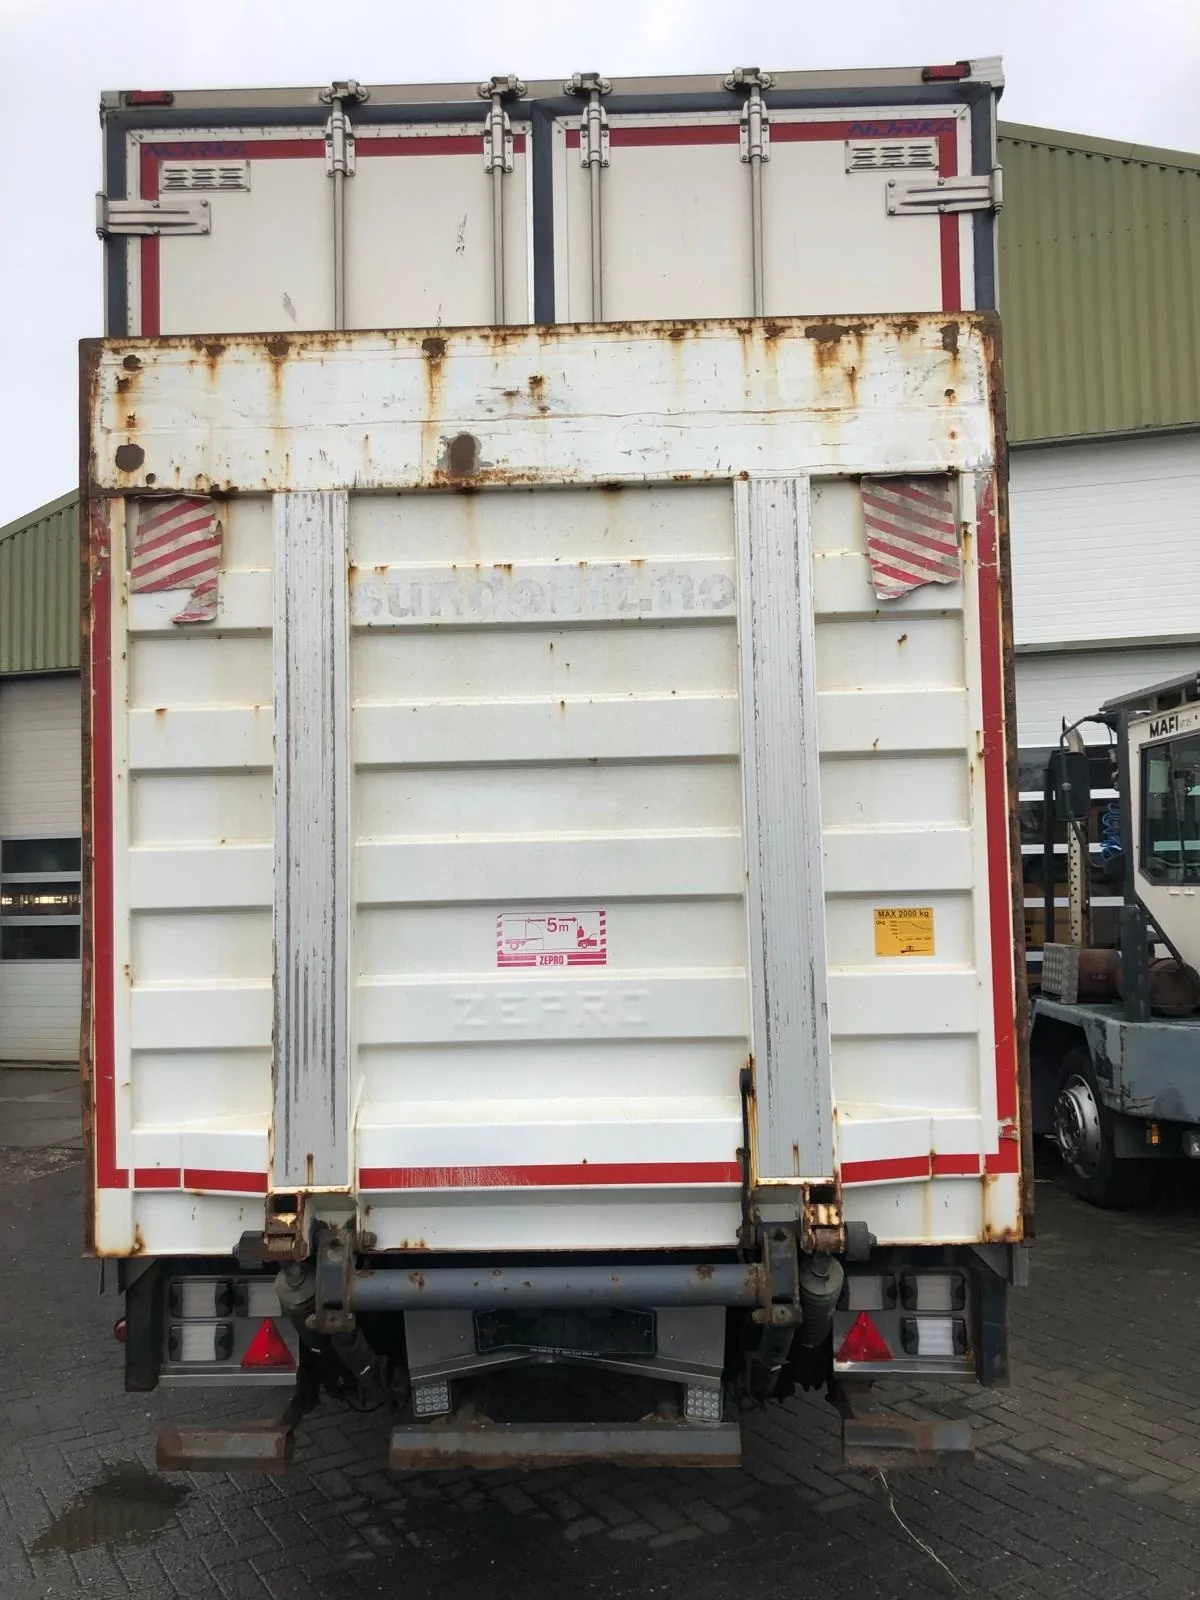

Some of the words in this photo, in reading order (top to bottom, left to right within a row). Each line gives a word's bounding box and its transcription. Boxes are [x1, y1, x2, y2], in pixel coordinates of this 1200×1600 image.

[1150, 715, 1178, 738] MAFI
[878, 910, 897, 918] MAX
[899, 910, 917, 918] 2000
[920, 910, 929, 918] kg
[539, 954, 564, 966] ZEPRO
